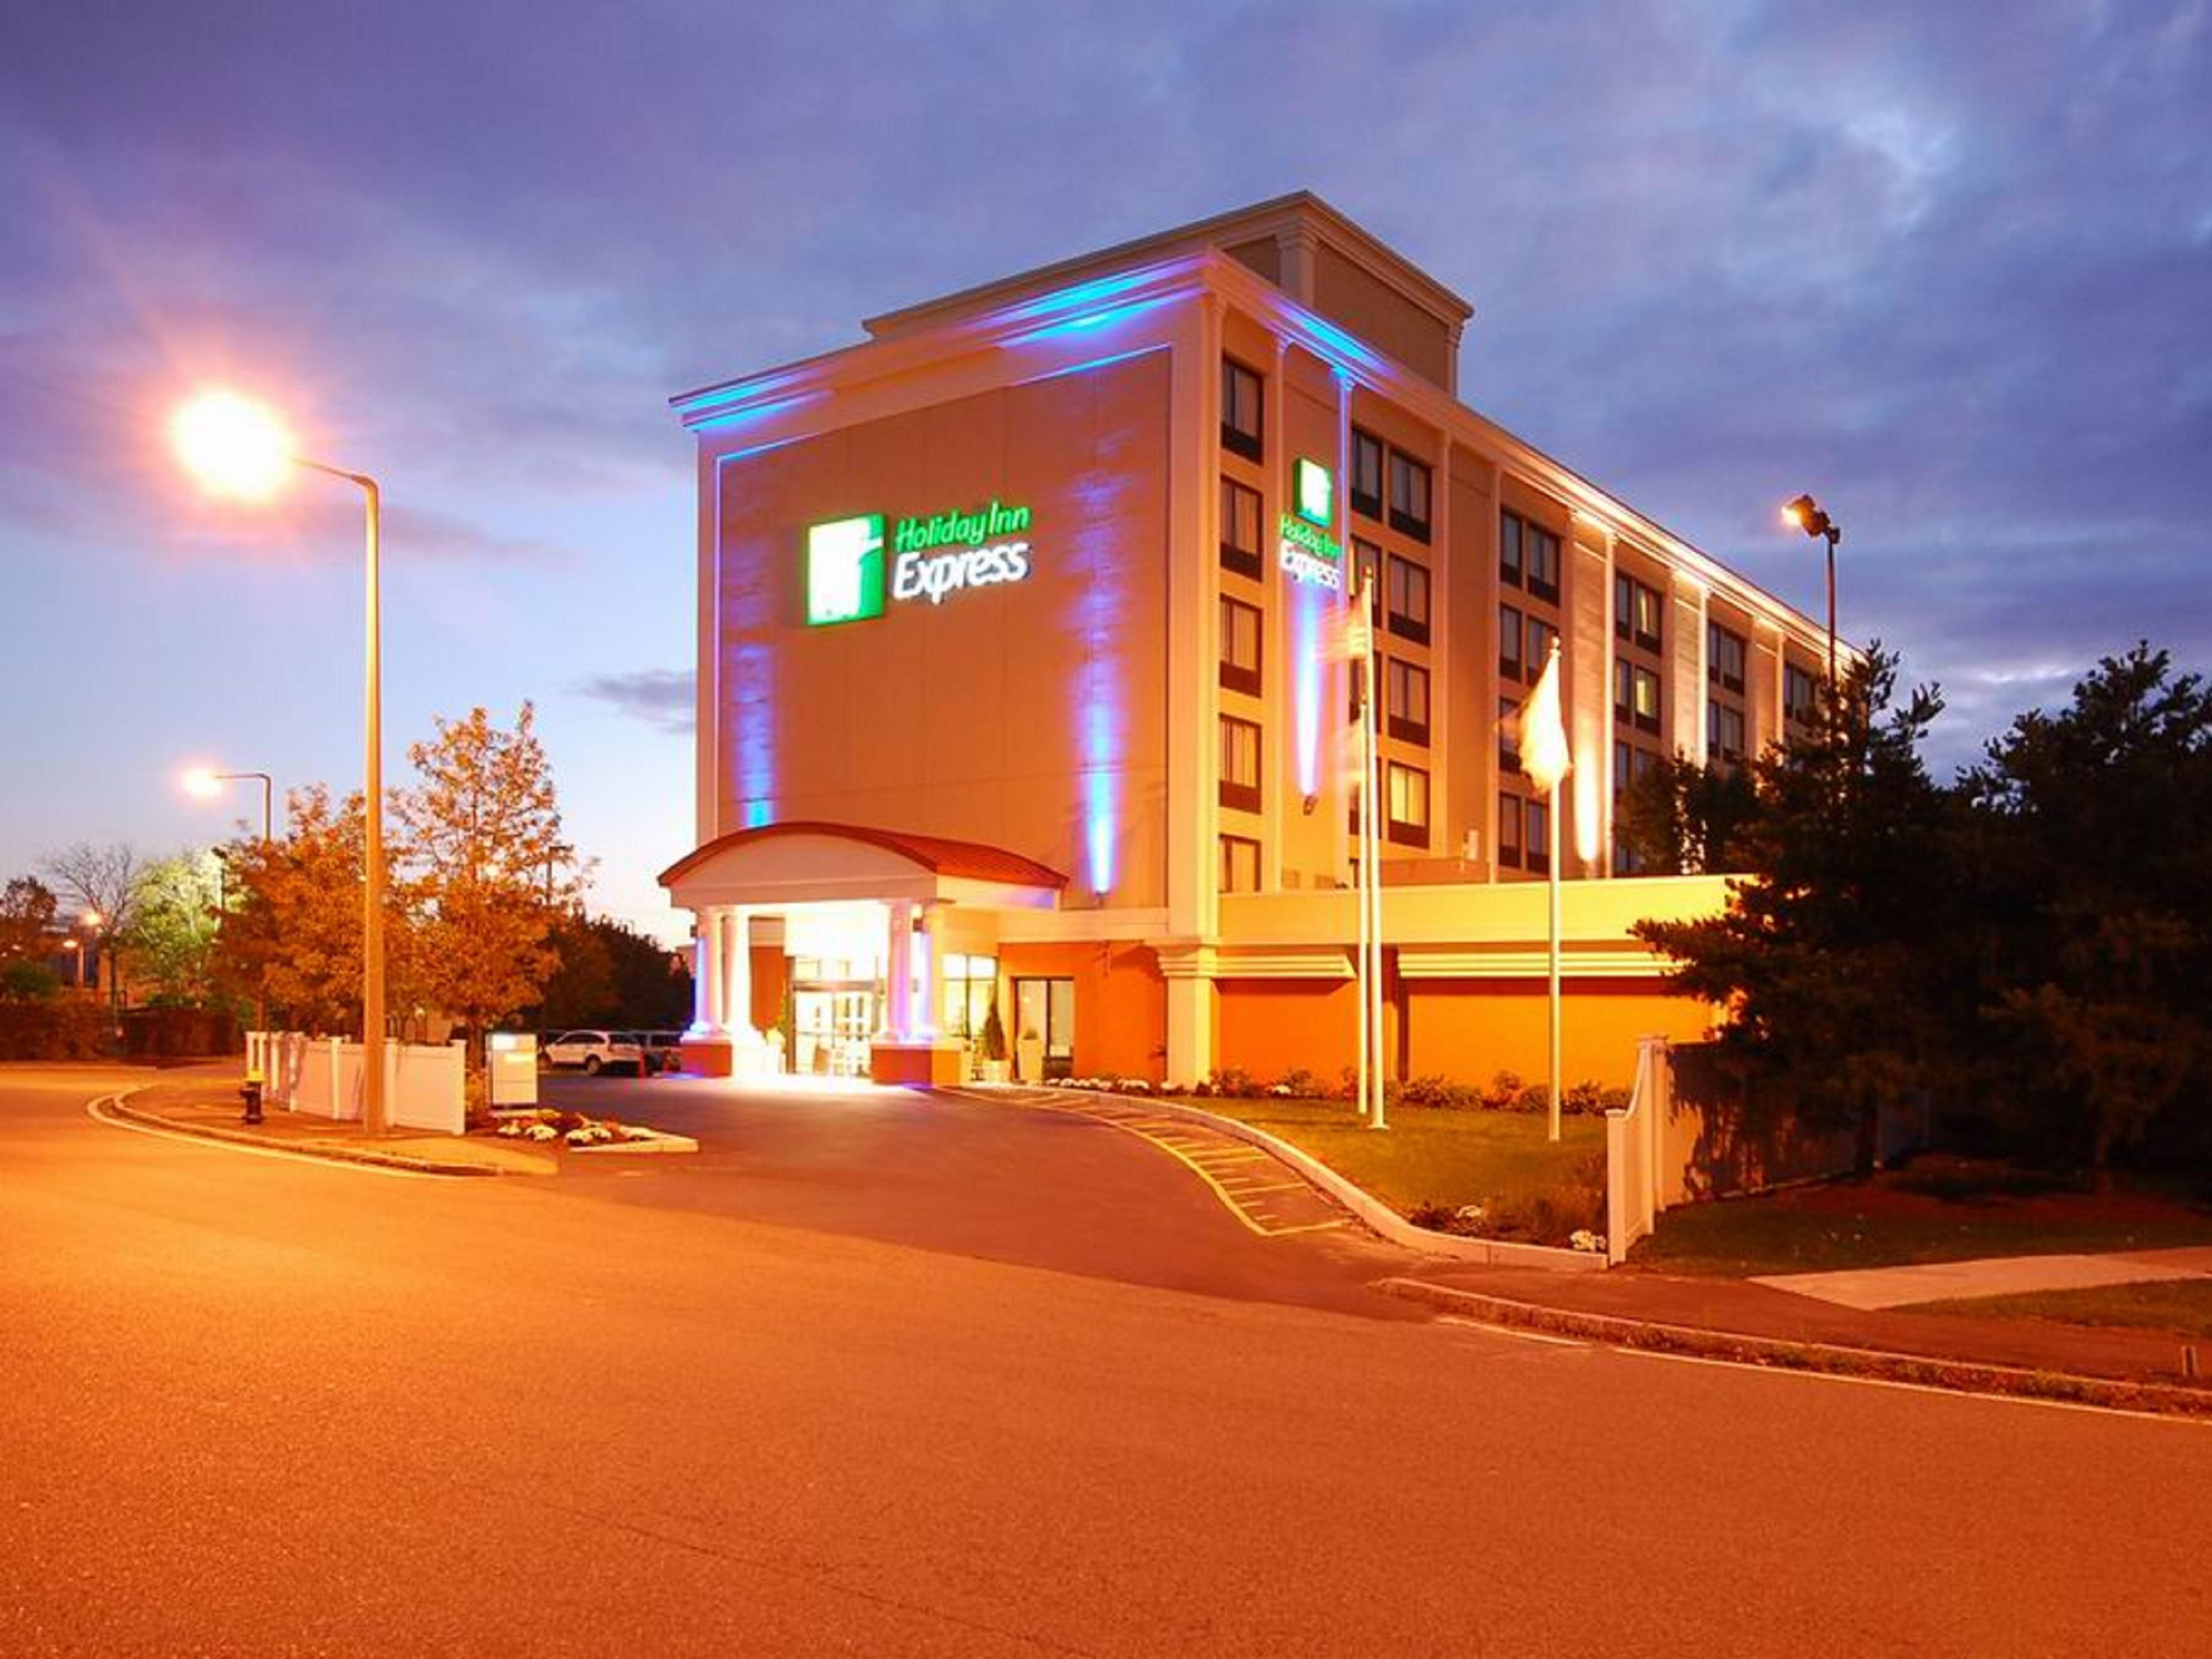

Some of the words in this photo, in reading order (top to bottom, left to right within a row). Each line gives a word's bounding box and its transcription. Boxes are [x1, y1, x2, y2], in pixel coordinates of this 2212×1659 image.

[896, 509, 985, 552] Holiday
[989, 500, 1031, 535] Inn
[893, 542, 1031, 604] Express
